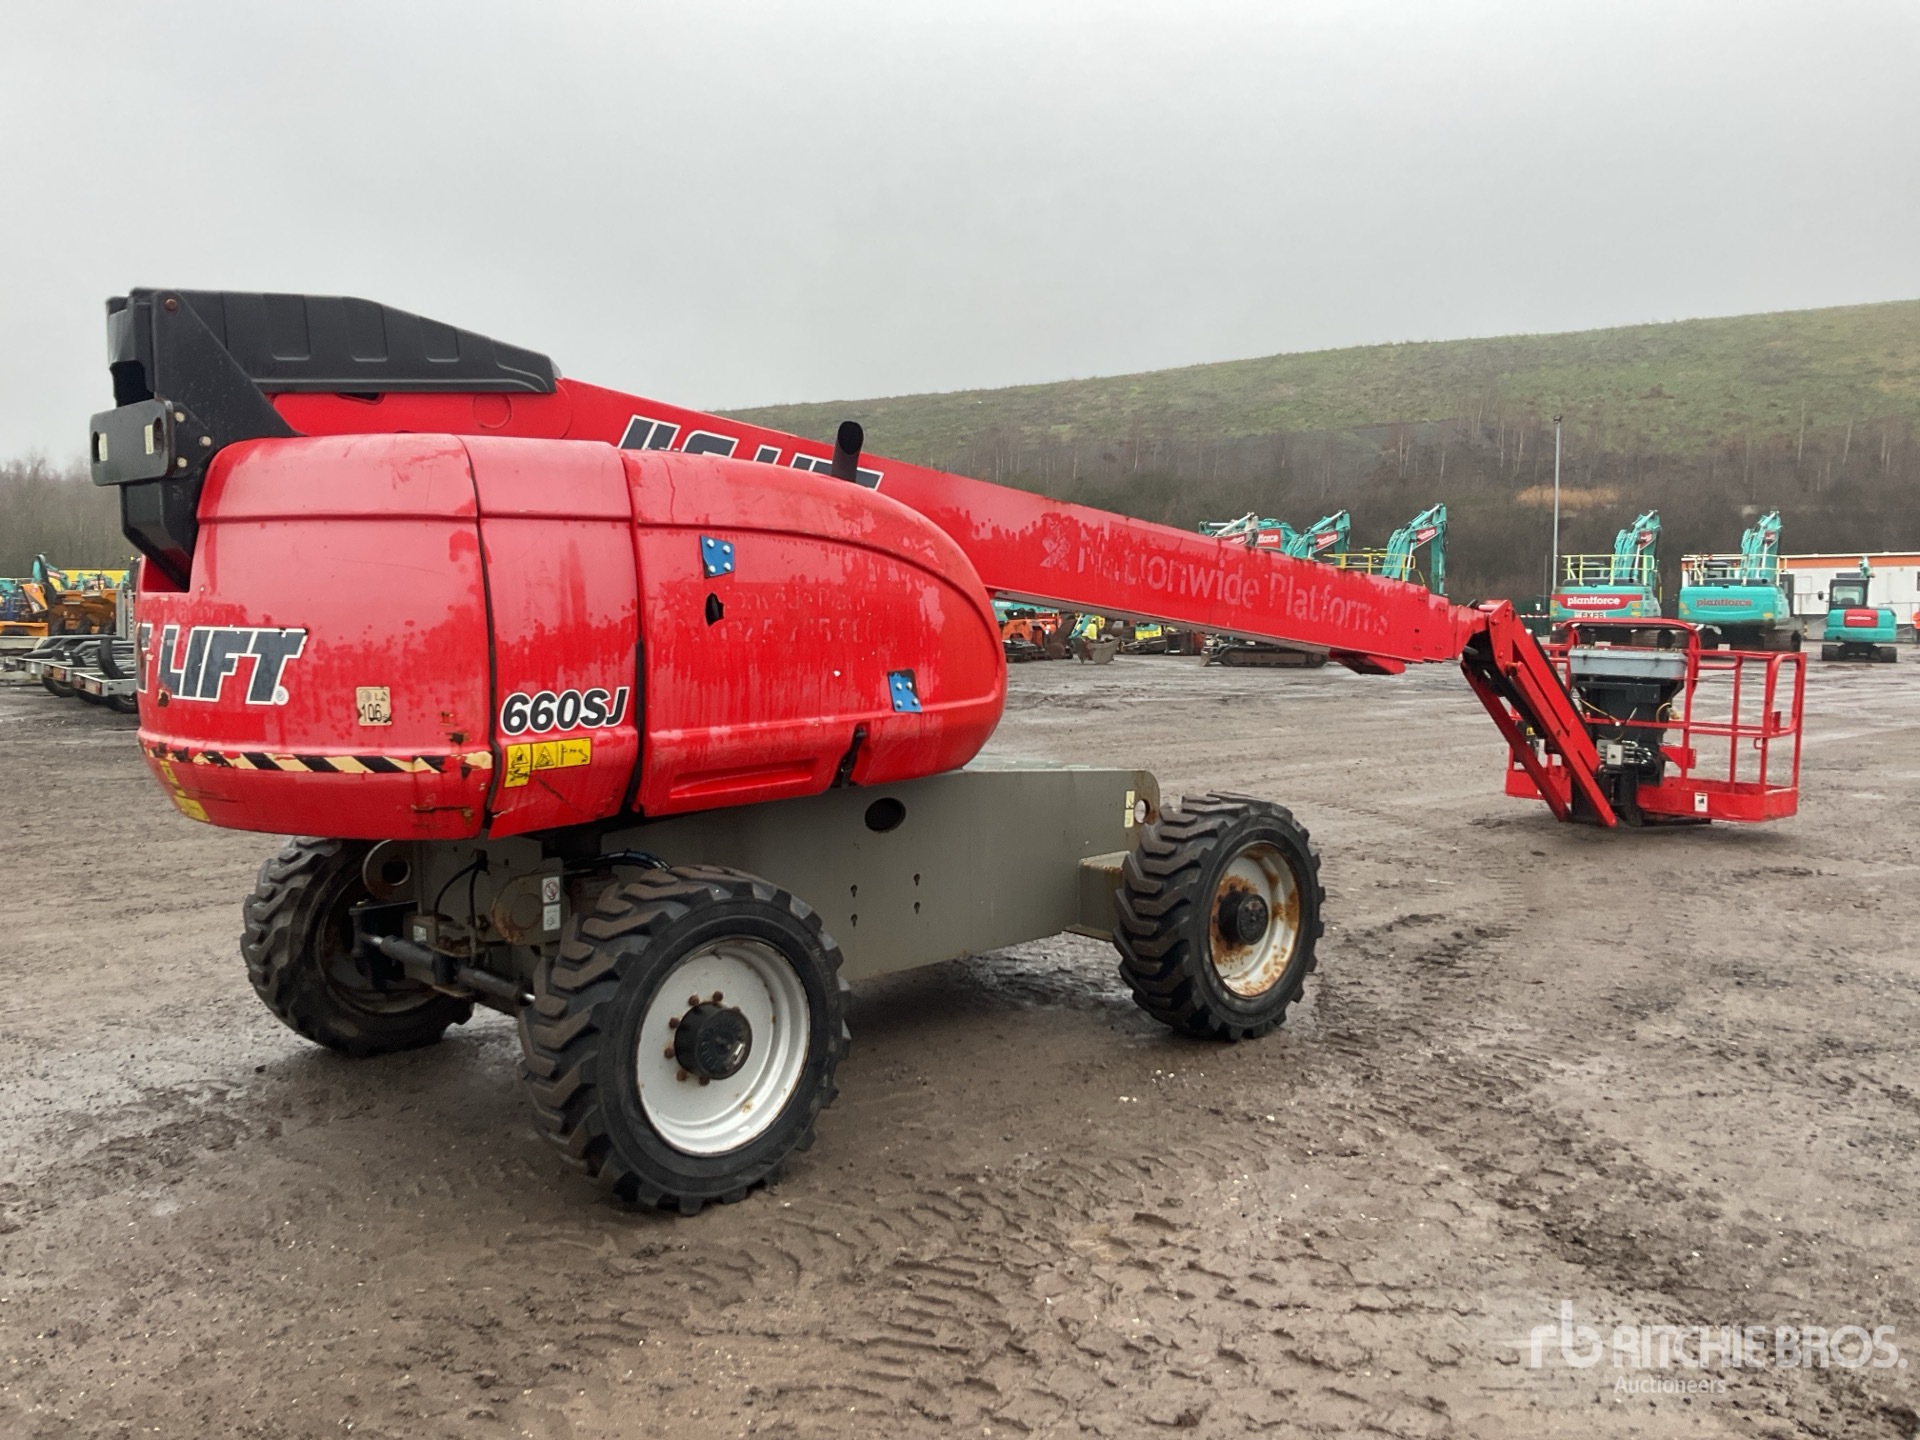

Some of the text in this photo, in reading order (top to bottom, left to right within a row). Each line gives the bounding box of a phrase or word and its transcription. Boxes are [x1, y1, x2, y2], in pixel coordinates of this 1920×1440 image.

[1269, 571, 1389, 636] Platforms
[1567, 596, 1621, 607] plantforce
[158, 625, 309, 706] LIFT
[500, 686, 630, 736] 660SJ
